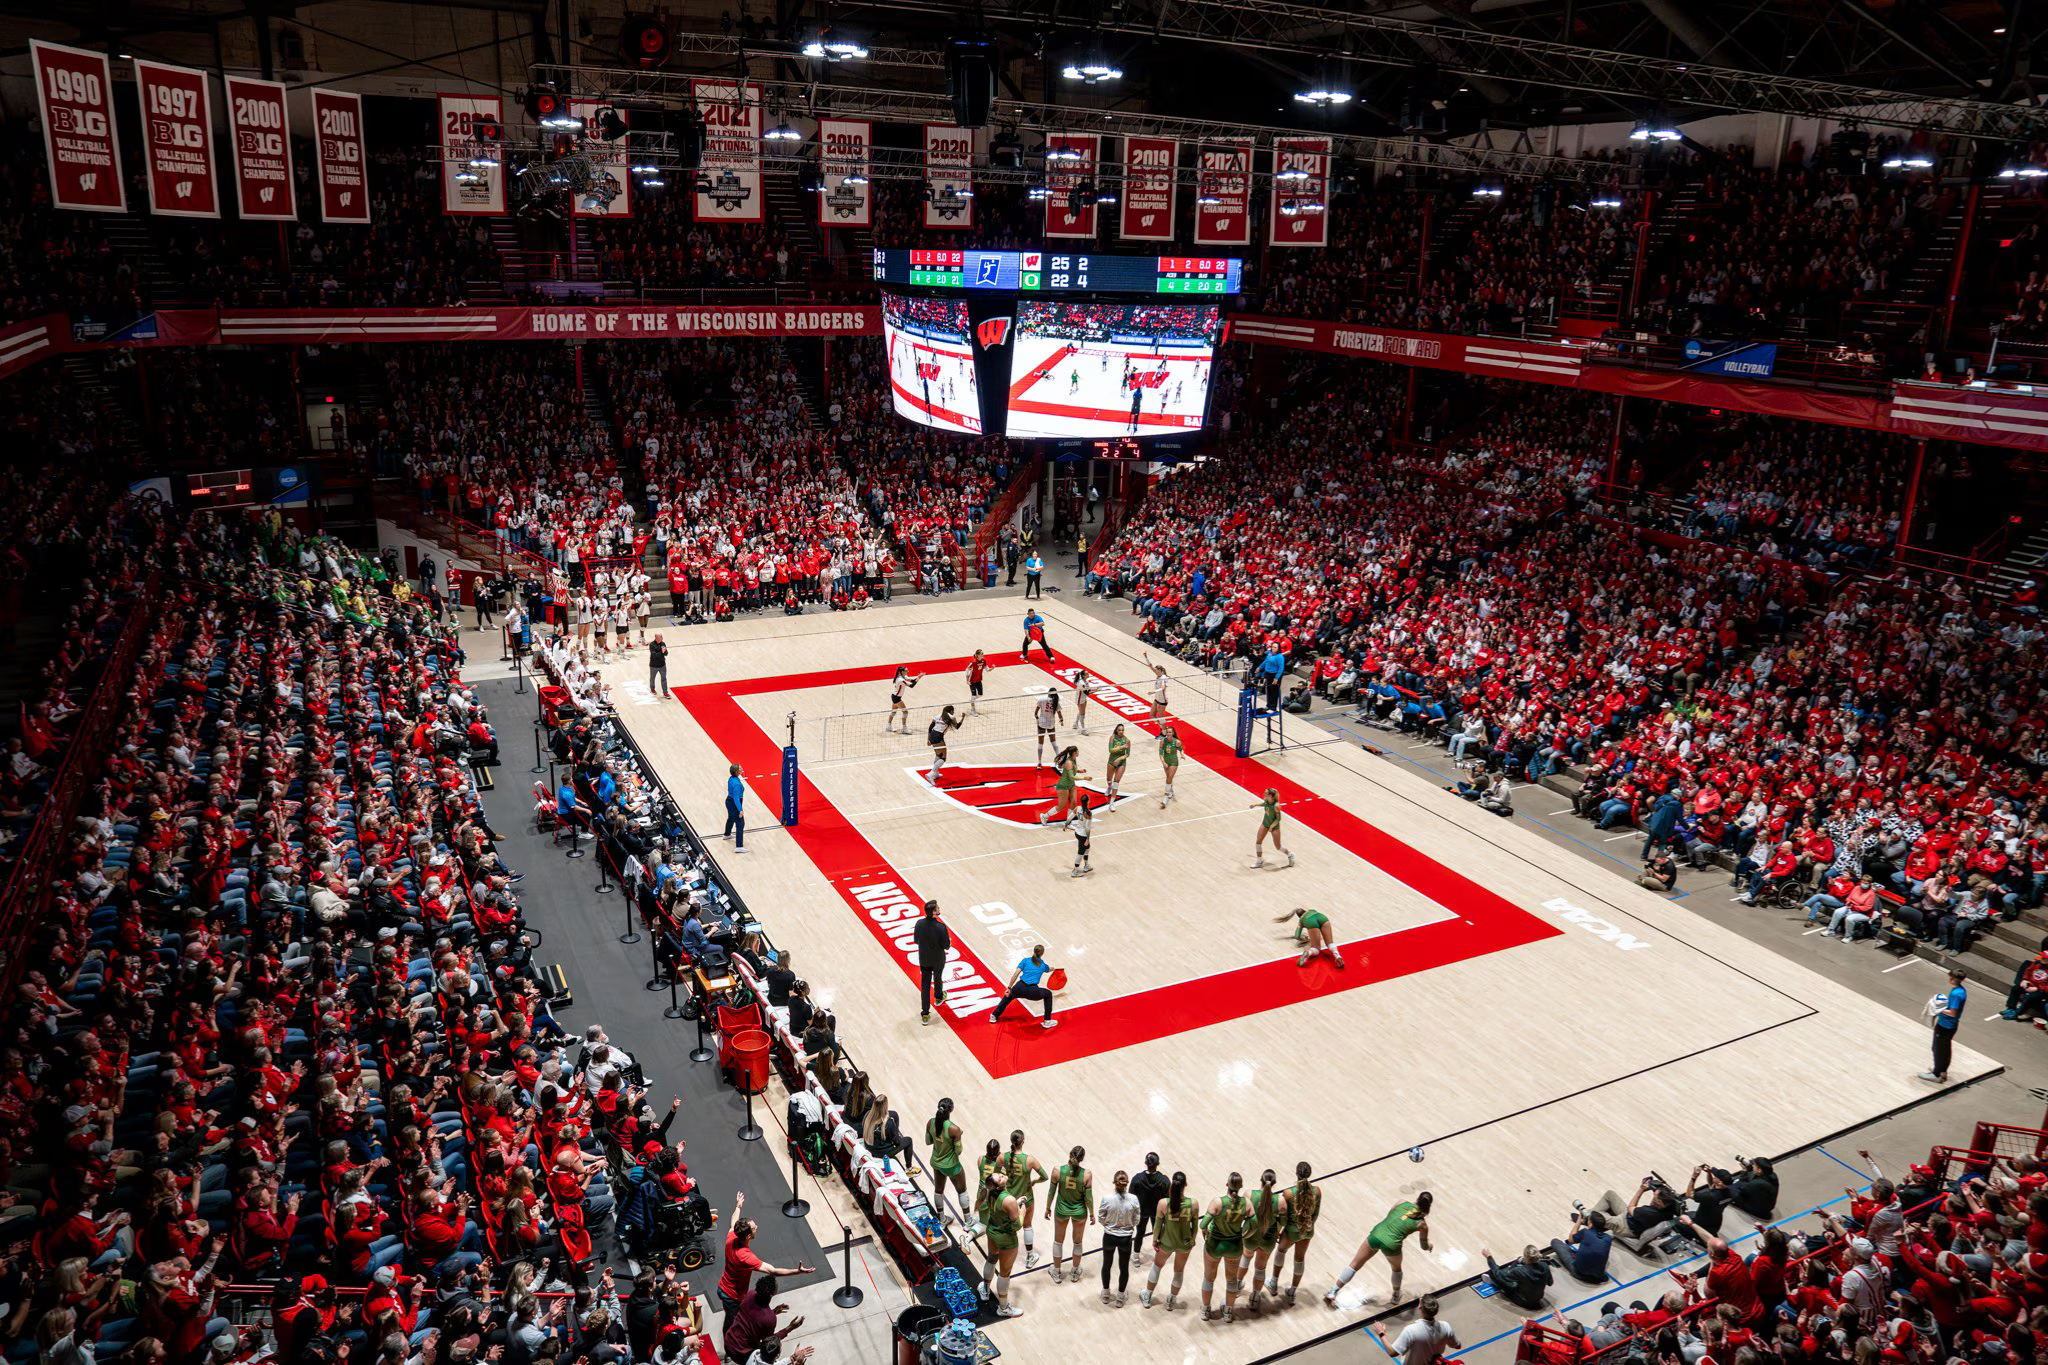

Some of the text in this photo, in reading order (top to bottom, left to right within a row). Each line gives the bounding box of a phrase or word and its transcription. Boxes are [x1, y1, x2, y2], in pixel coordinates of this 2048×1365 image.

[46, 66, 101, 106] 1990
[148, 84, 198, 119] 1997
[235, 98, 281, 128] 2000
[321, 108, 356, 137] 2001
[56, 138, 109, 153] VOLLEYBALL
[827, 133, 863, 155] 2019
[931, 138, 968, 160] 2020
[57, 150, 111, 166] CHAMPIONS
[155, 149, 205, 163] VOLLEYBALL
[1132, 149, 1170, 171] 2019
[1281, 152, 1321, 174] 2021
[156, 160, 207, 175] CHAMPIONS
[242, 158, 284, 169] VOLLEYBALL
[325, 165, 360, 175] VOLLEYBALL
[243, 169, 285, 180] CHAMPIONS
[326, 175, 361, 186] CHAMPIONS
[1129, 193, 1168, 201] VOLLEYBALL
[1129, 201, 1168, 210] CHAMPIONS
[1203, 205, 1243, 214] CHAMPIONS
[926, 252, 931, 262] 2
[952, 253, 960, 262] 22
[1051, 257, 1070, 270] 25
[1078, 257, 1088, 271] 2
[1170, 260, 1175, 269] 1
[1185, 260, 1191, 269] 2
[1215, 261, 1225, 270] 22
[926, 274, 931, 283] 2
[952, 276, 960, 284] 21
[1050, 274, 1069, 288] 22
[1077, 275, 1088, 288] 4
[1168, 282, 1174, 290] 4
[1184, 282, 1190, 291] 2
[1215, 282, 1223, 291] 21
[532, 312, 865, 332] HOME OF THE WISCONSIN BADGERS
[1724, 361, 1769, 375] VOLLEYBALL
[1102, 448, 1140, 458] 2 2 4
[1065, 1175, 1077, 1190] 6
